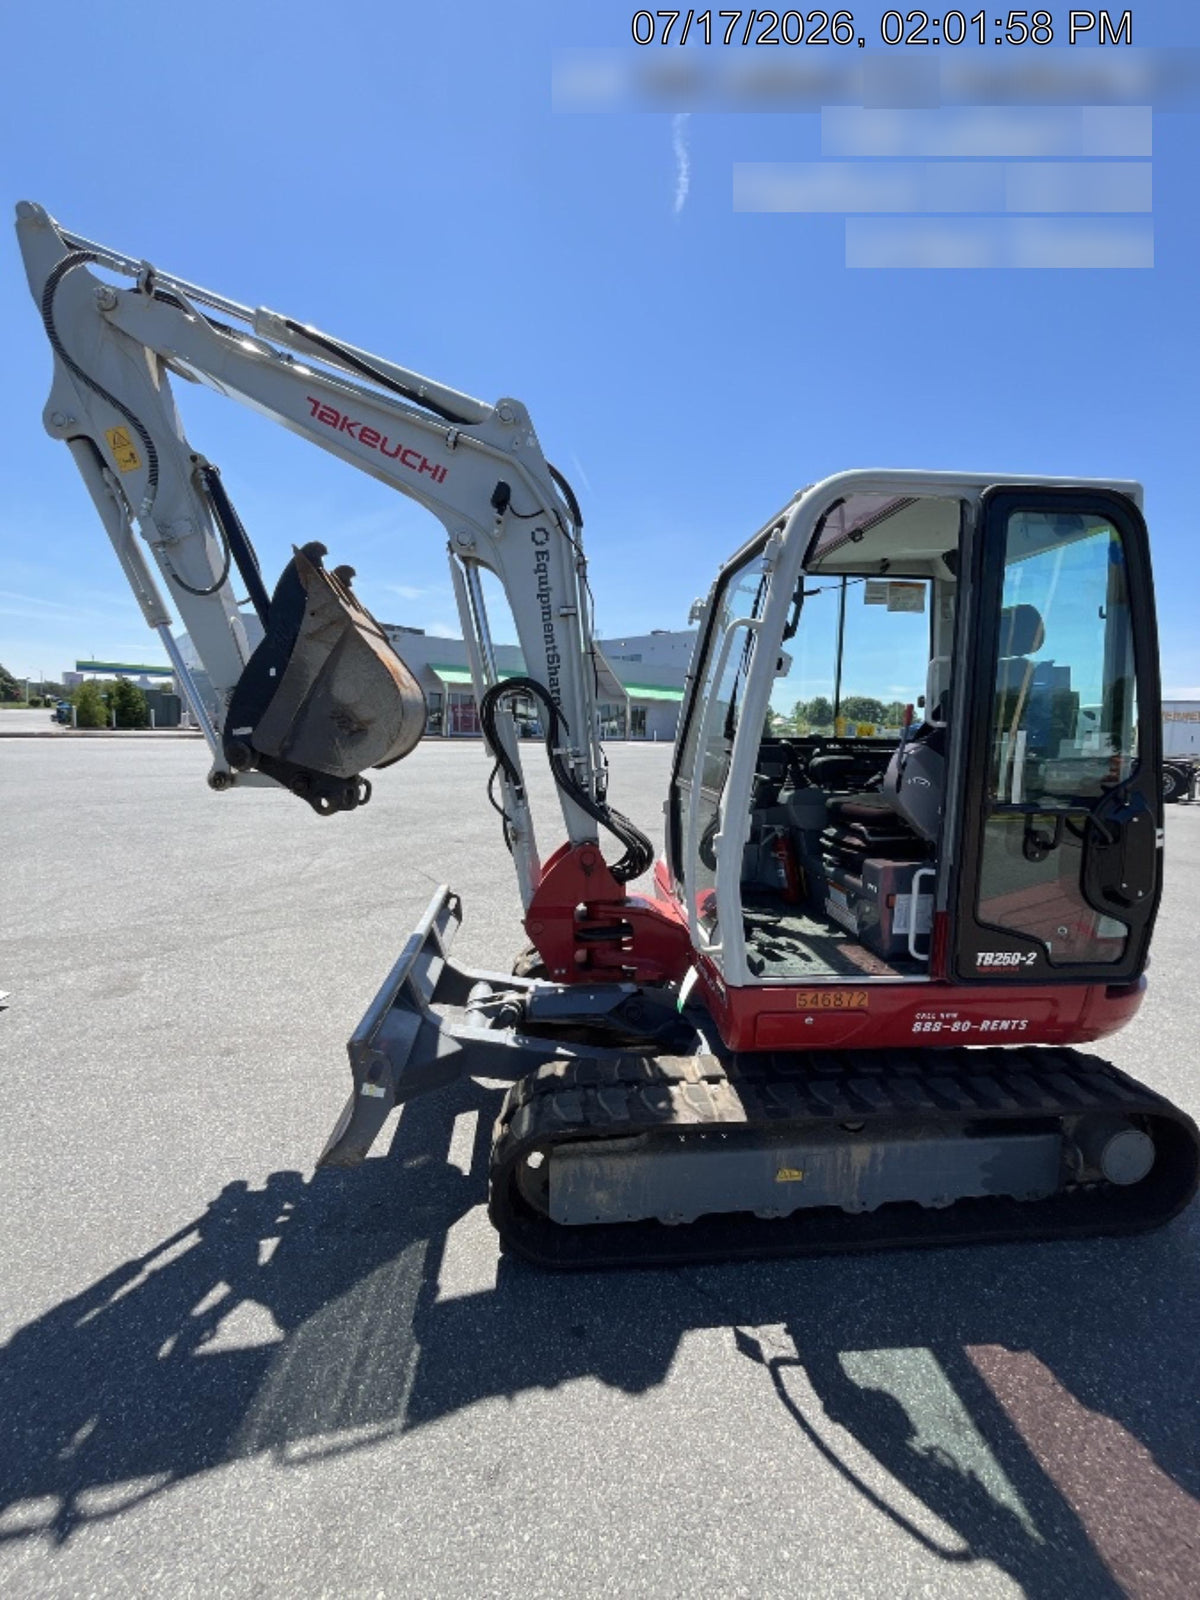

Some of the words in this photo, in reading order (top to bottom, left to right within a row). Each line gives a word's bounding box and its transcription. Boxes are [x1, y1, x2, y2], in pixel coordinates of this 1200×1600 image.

[306, 396, 449, 484] TAKEUCHI
[975, 951, 1037, 967] TB250-2
[797, 991, 867, 1007] 546872
